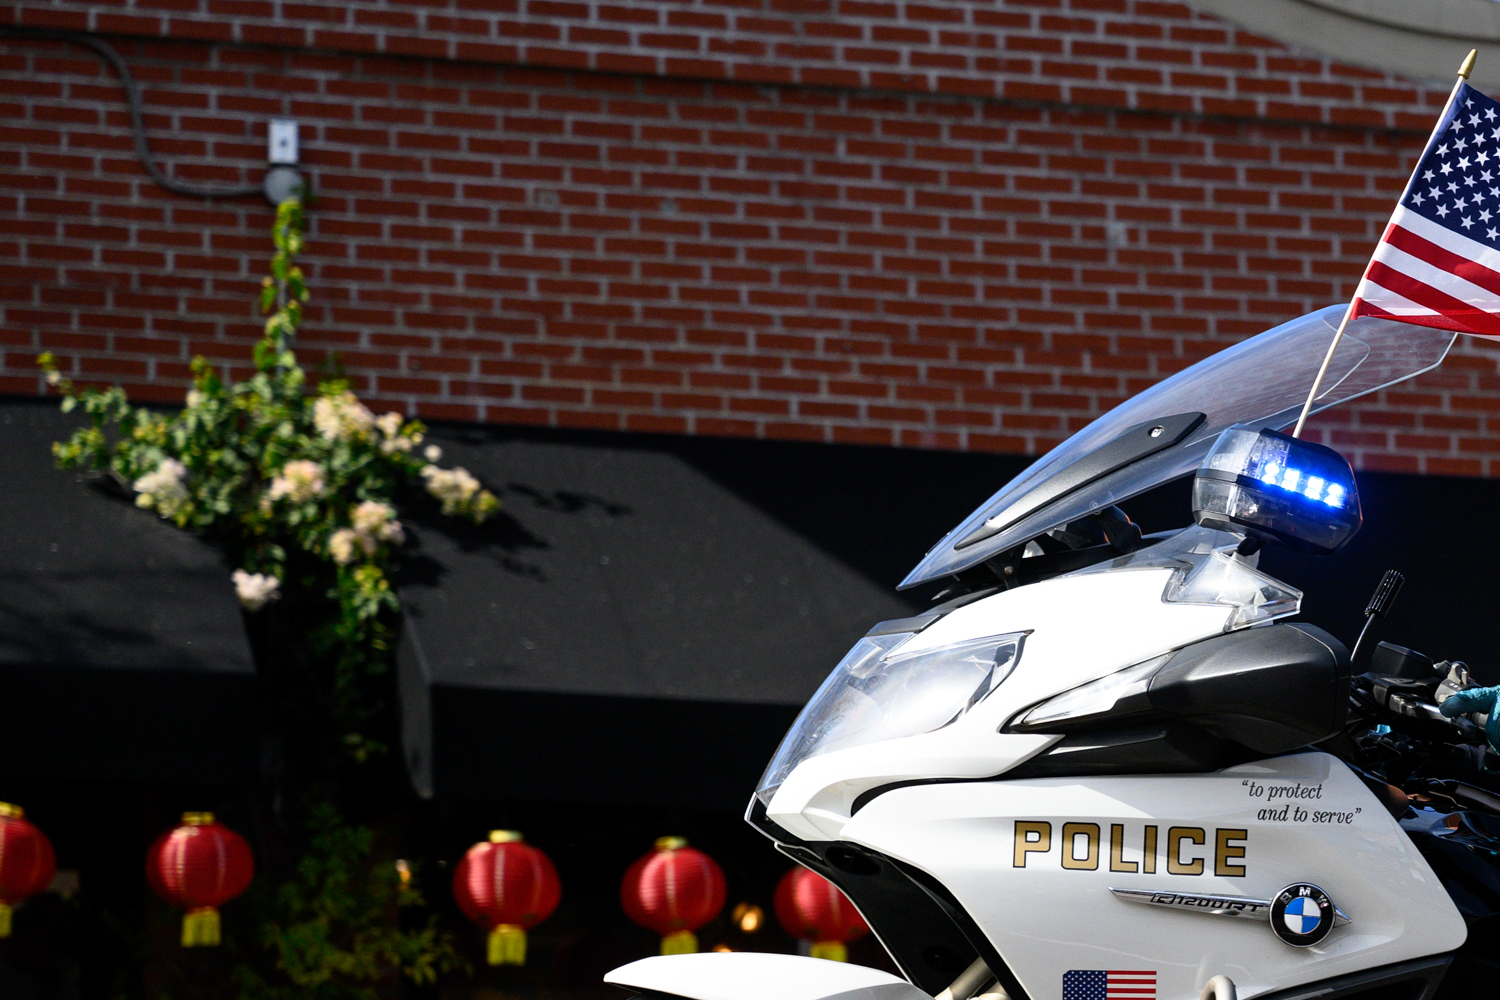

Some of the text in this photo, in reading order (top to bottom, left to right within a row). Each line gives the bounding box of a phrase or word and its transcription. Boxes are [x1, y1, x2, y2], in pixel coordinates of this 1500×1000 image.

[1267, 783, 1323, 801] protect
[1257, 804, 1289, 822] and
[1293, 806, 1308, 822] to
[1012, 820, 1249, 878] POLICE
[1279, 886, 1331, 909] BMW
